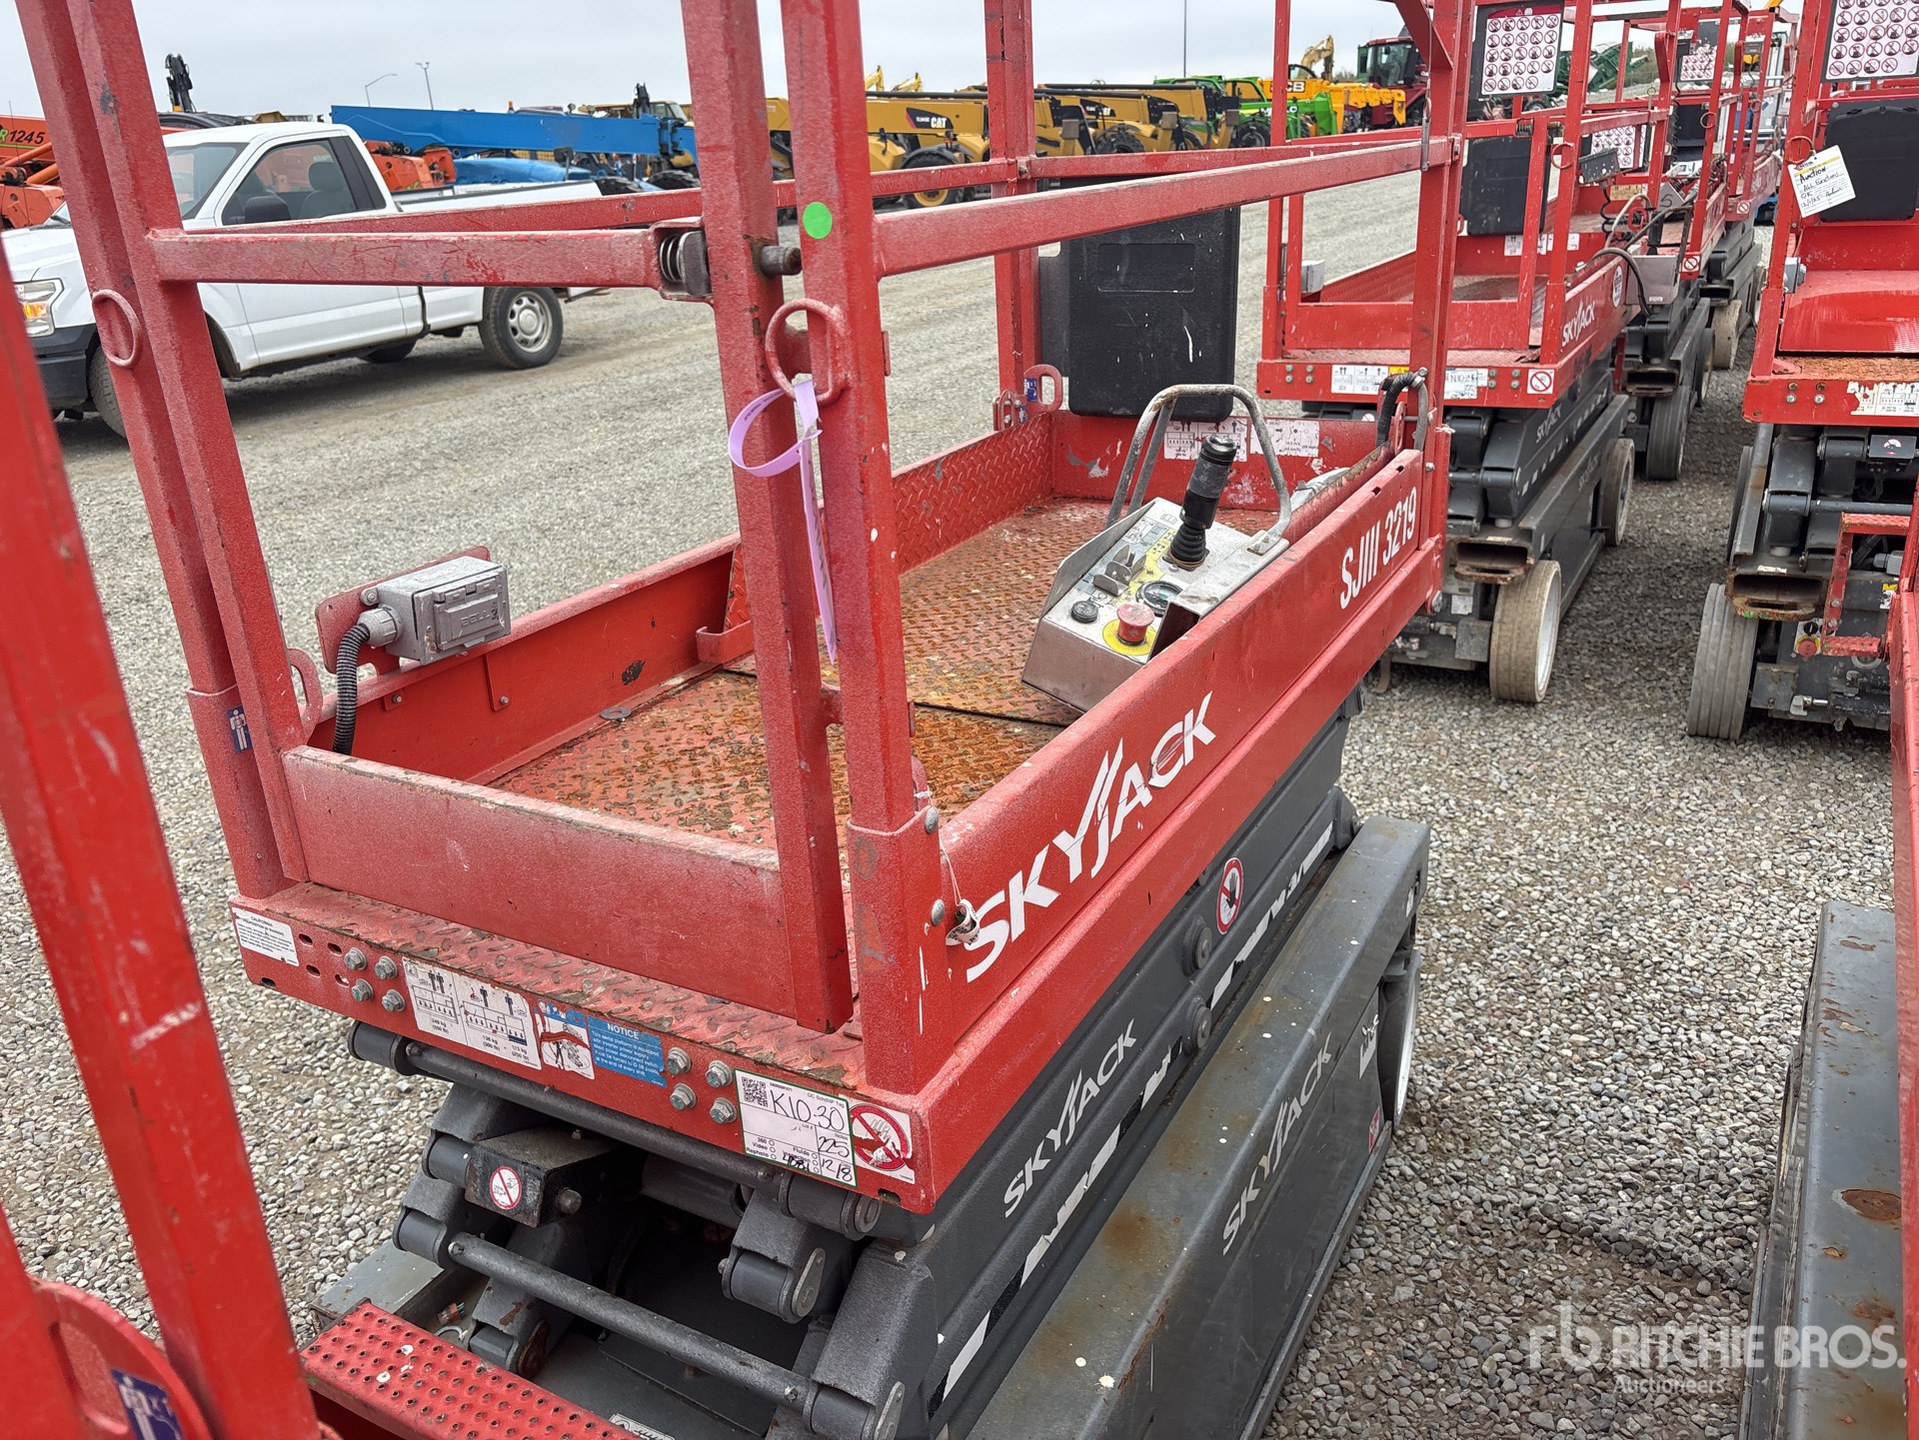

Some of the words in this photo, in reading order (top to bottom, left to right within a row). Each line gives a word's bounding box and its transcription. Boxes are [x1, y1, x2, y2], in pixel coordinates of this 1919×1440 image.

[930, 117, 947, 128] CAT
[1382, 486, 1417, 566] 3219
[964, 690, 1217, 984] SKYJACK
[606, 1022, 640, 1040] NOTICE
[752, 1142, 768, 1150] Video
[1004, 1017, 1137, 1218] SKYJACK
[1223, 1031, 1332, 1256] SKYJACK
